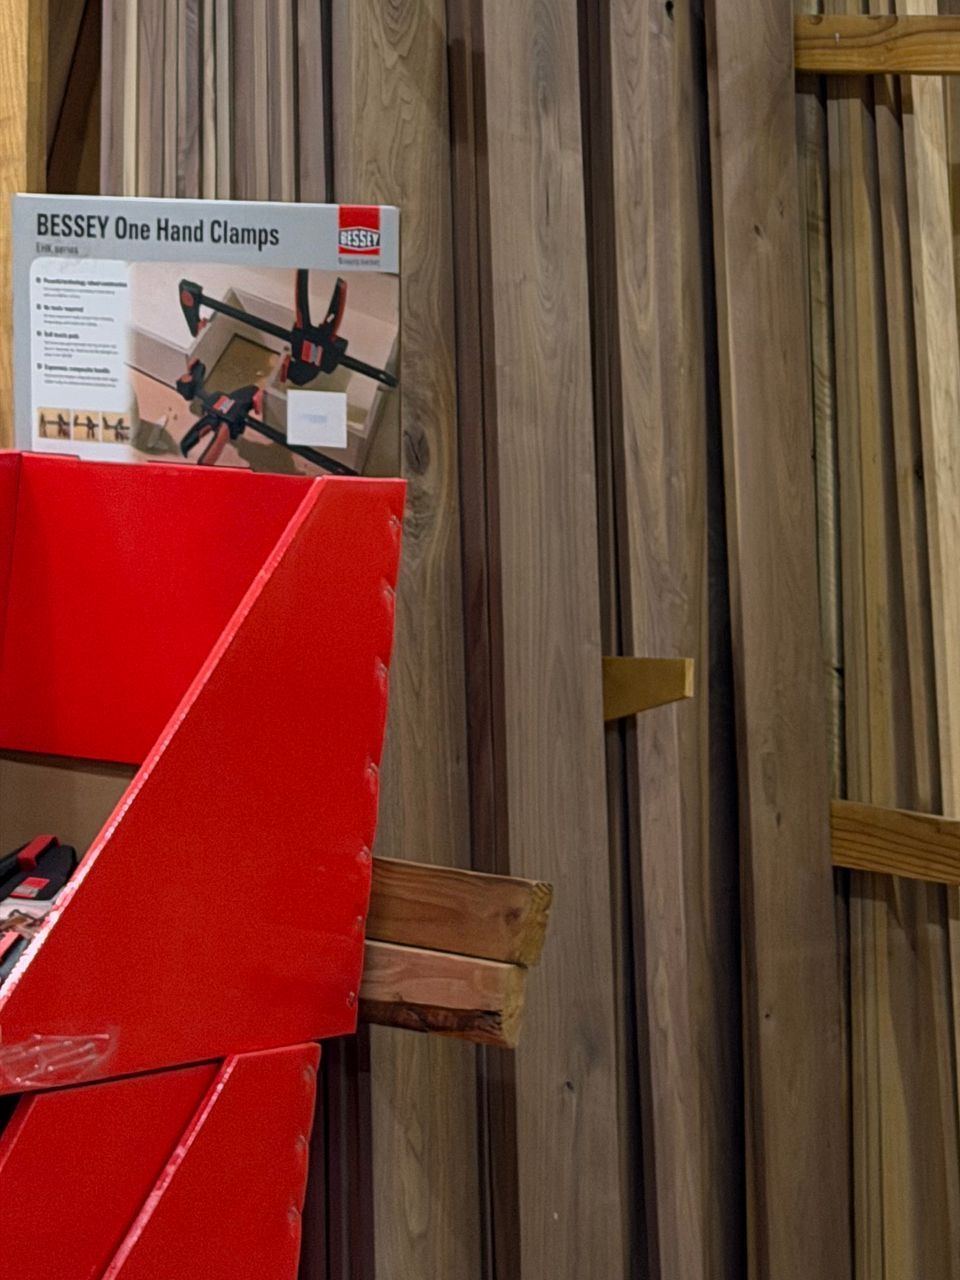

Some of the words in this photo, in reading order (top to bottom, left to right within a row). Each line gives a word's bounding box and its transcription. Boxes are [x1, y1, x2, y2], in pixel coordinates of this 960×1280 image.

[37, 213, 109, 239] BESSEY
[115, 216, 151, 240] One
[156, 217, 204, 243] Hand
[210, 219, 280, 252] Clamps
[340, 230, 380, 247] BESSEY
